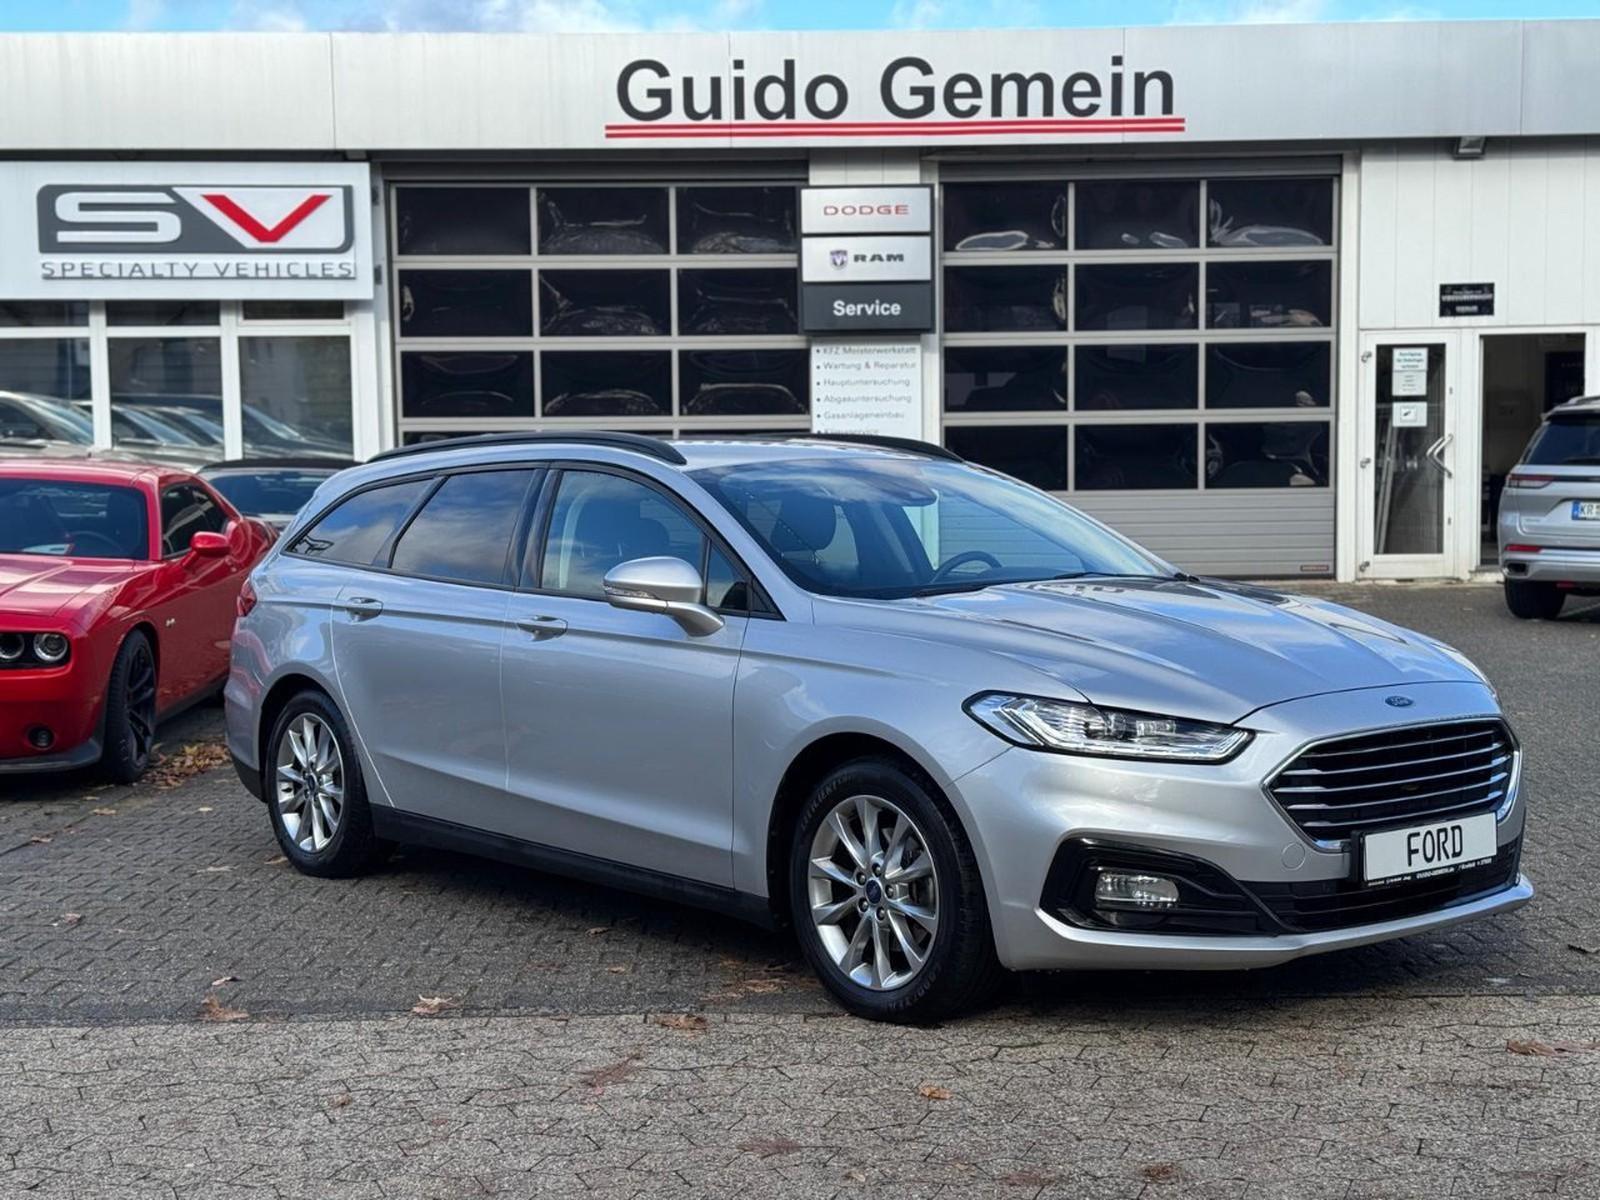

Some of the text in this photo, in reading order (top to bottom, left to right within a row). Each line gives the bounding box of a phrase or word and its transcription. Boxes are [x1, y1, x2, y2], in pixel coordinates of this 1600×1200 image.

[616, 55, 1175, 122] Guido Gemein
[823, 204, 909, 216] DODGE
[853, 253, 905, 263] RAM
[41, 262, 353, 278] SPECIALTY VEHICLES
[832, 299, 902, 317] Service
[823, 361, 917, 371] Wartung & Reparatur
[823, 378, 910, 388] Hauptuntersuchung
[823, 394, 912, 404] Abgasuntersuchung
[1406, 824, 1464, 867] FORD
